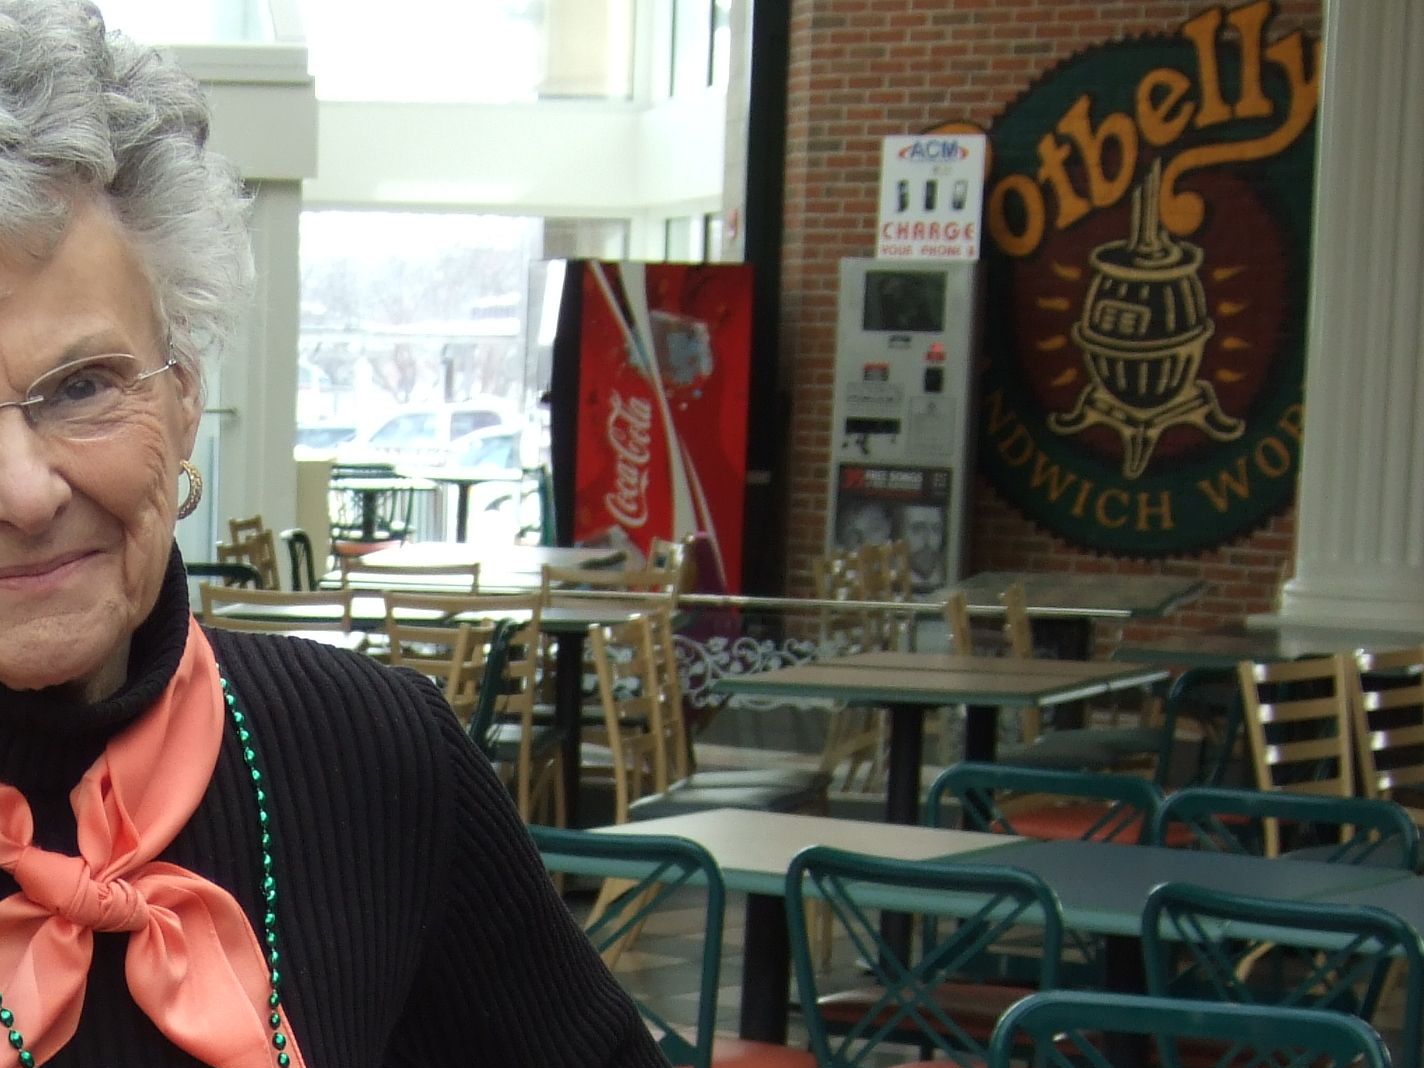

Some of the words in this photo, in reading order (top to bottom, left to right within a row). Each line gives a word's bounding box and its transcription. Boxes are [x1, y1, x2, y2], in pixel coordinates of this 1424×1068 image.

[910, 141, 959, 162] ACM
[921, 1, 1324, 256] otbelly
[882, 222, 975, 240] CHARGE
[982, 388, 1175, 531] NDWICH
